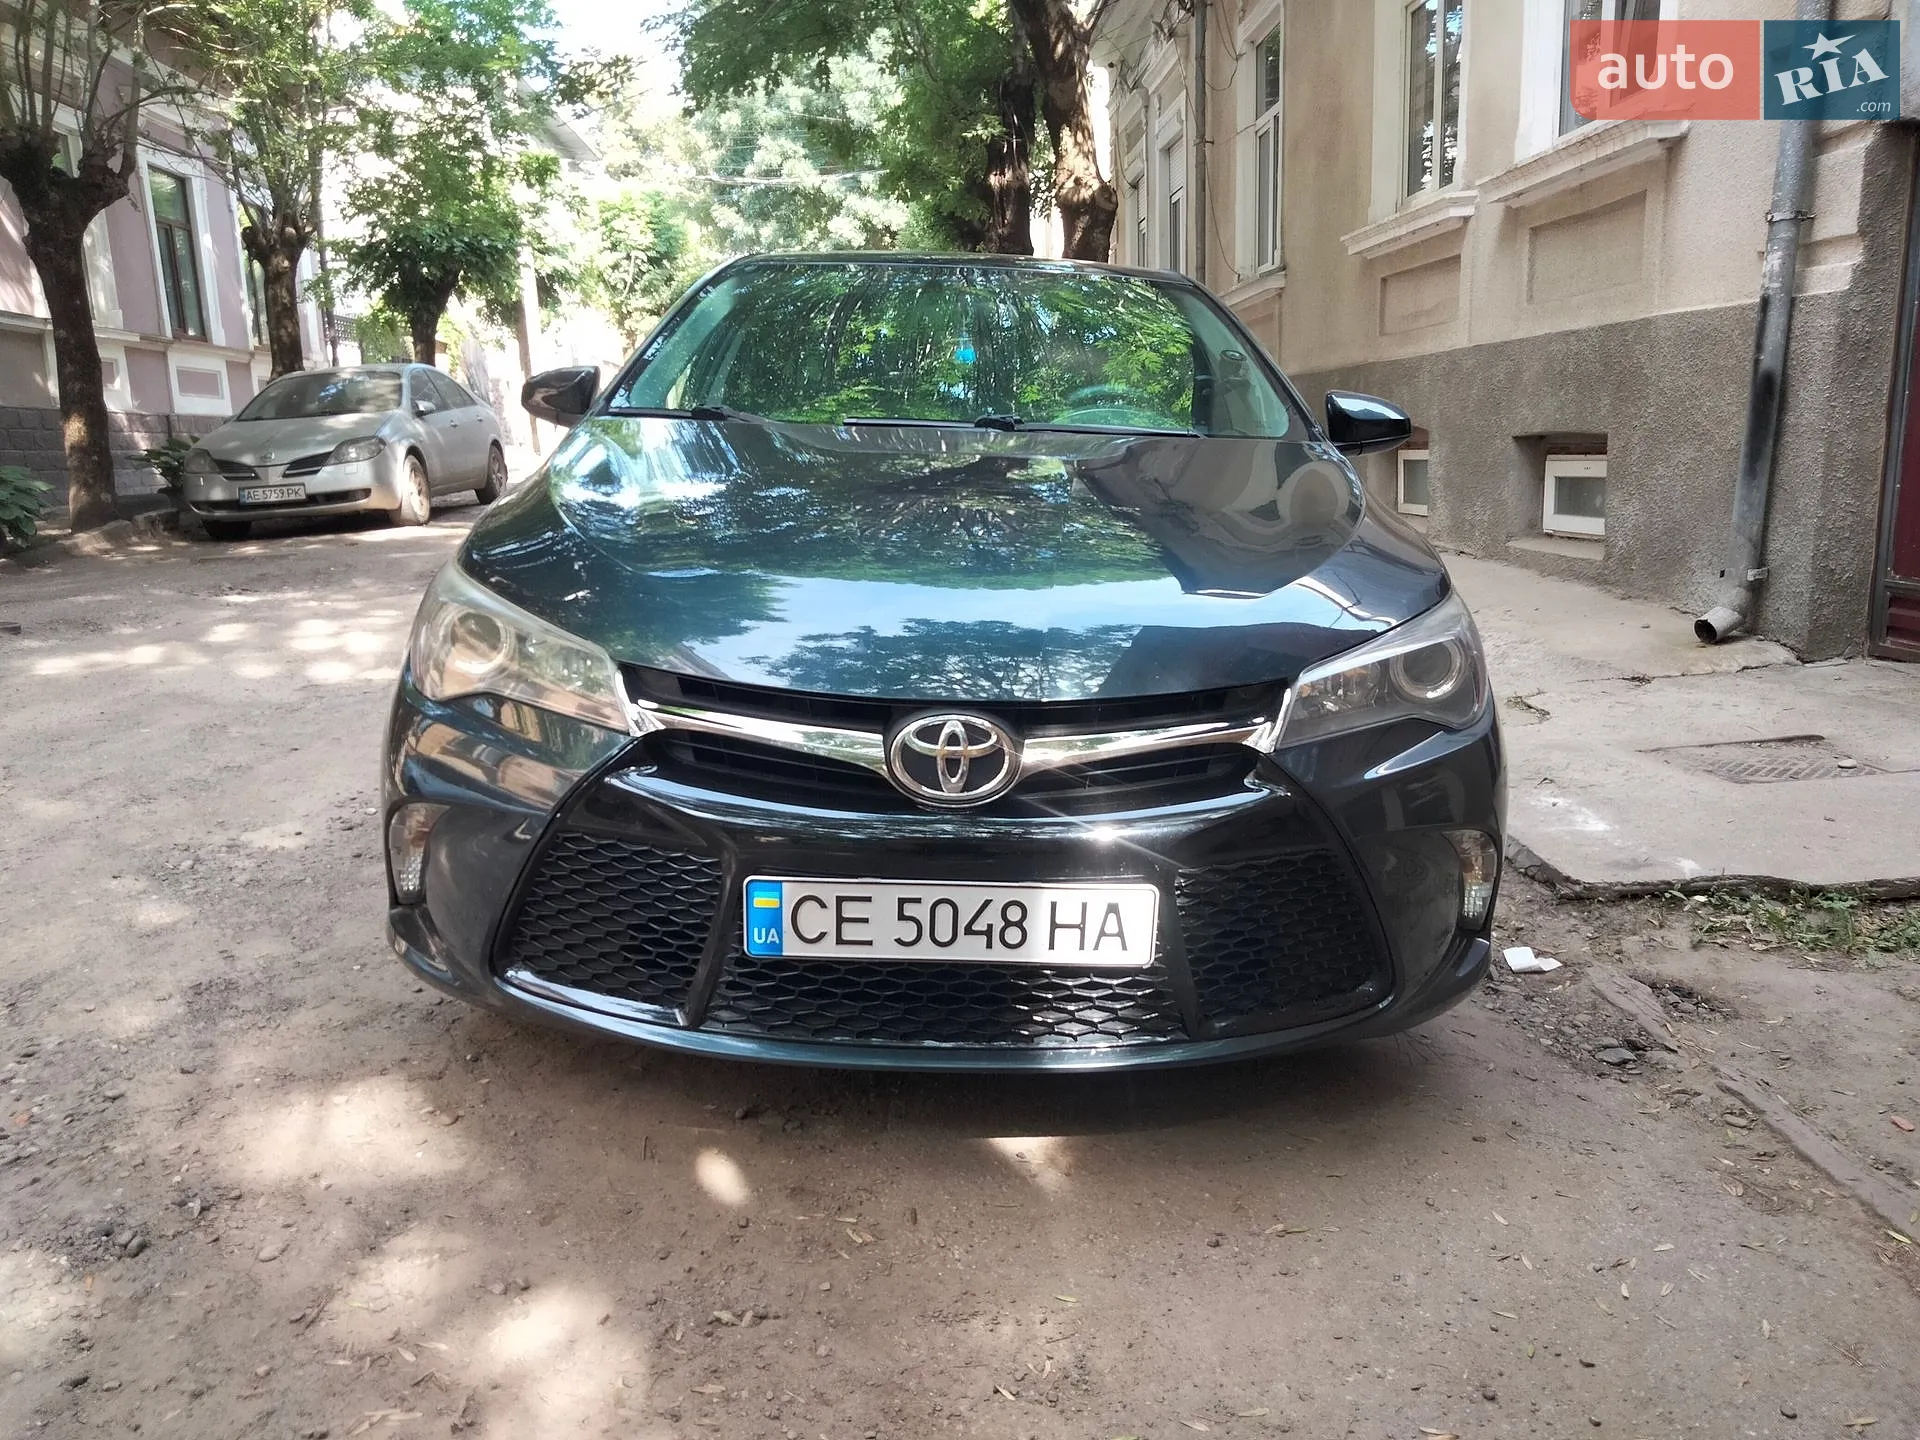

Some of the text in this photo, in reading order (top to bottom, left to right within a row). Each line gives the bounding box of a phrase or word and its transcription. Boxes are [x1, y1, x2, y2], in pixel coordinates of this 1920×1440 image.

[246, 490, 259, 500] AE
[262, 489, 285, 499] 5759
[790, 894, 1129, 951] CE 5048 HA
[753, 927, 780, 945] UA
